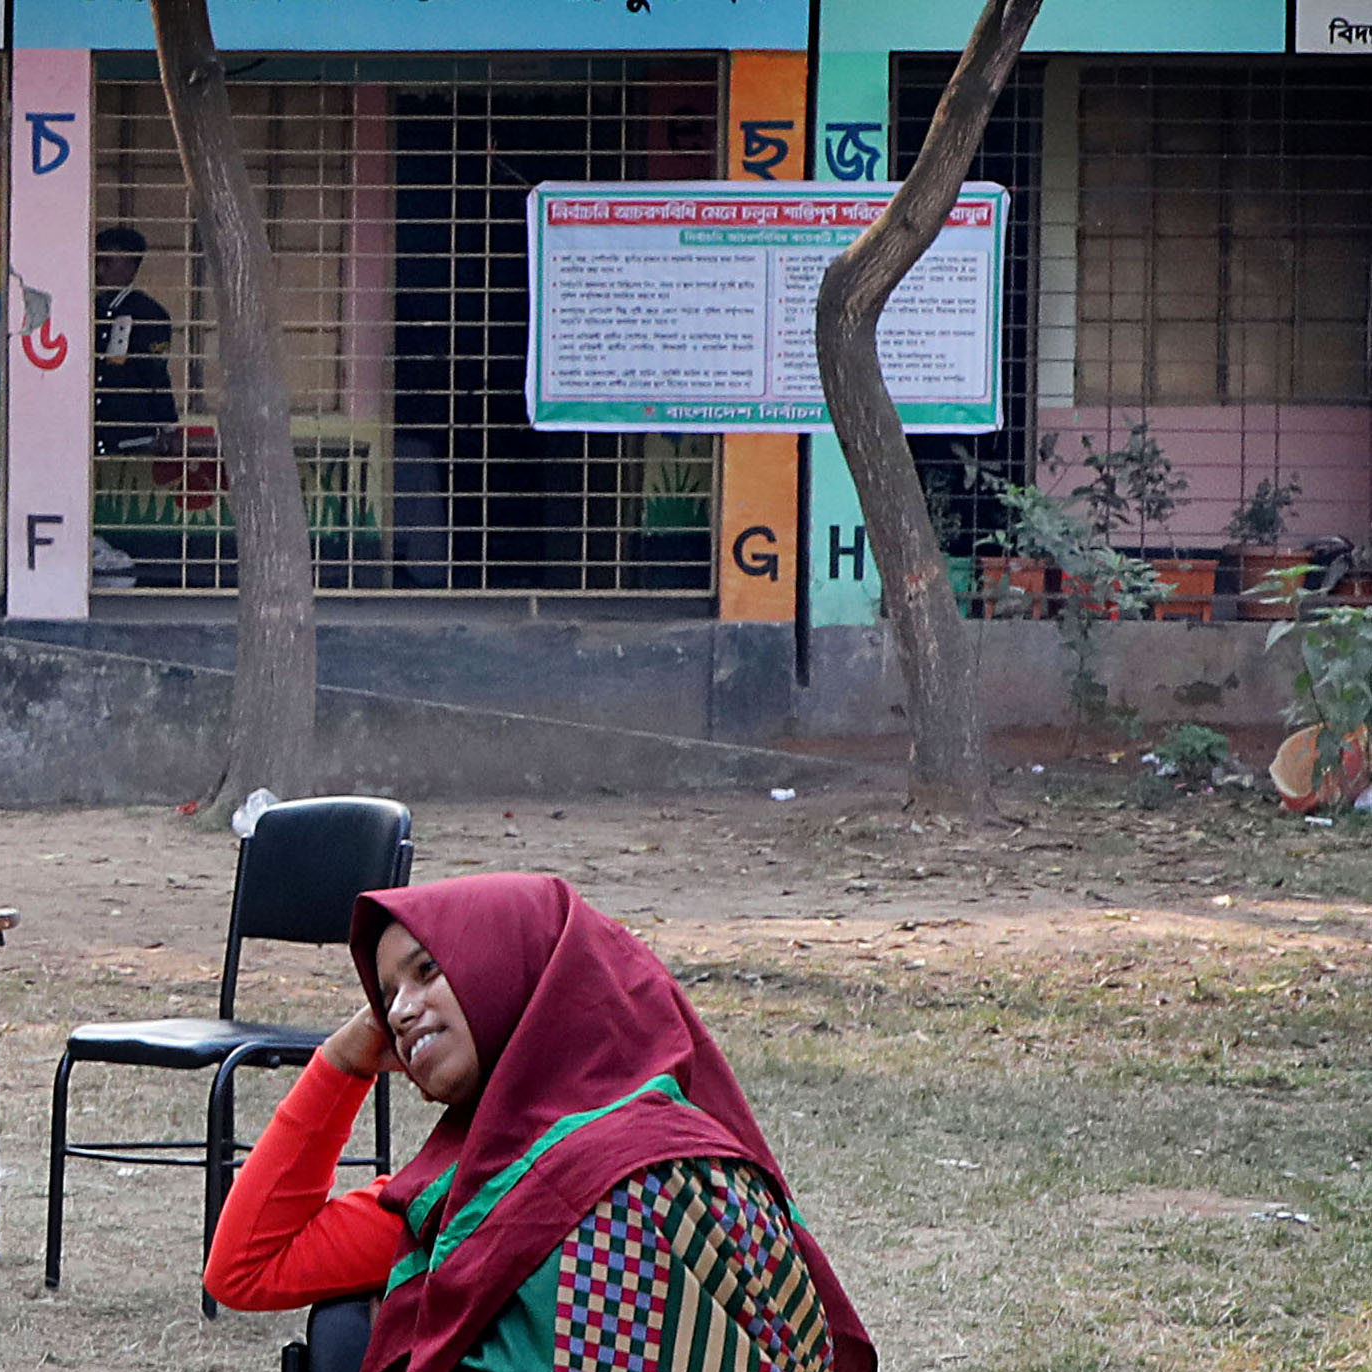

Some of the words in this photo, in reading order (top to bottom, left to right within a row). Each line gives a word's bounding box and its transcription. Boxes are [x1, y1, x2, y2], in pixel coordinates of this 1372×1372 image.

[25, 113, 75, 174] চ
[740, 120, 794, 181] ছ
[825, 123, 882, 181] জ
[702, 206, 736, 220] মেনে
[742, 206, 778, 224] চলুন
[666, 405, 752, 419] বাংলাদেশ
[758, 403, 823, 420] নির্বাচন
[27, 515, 63, 570] F
[733, 525, 778, 581] G
[829, 524, 865, 580] H
